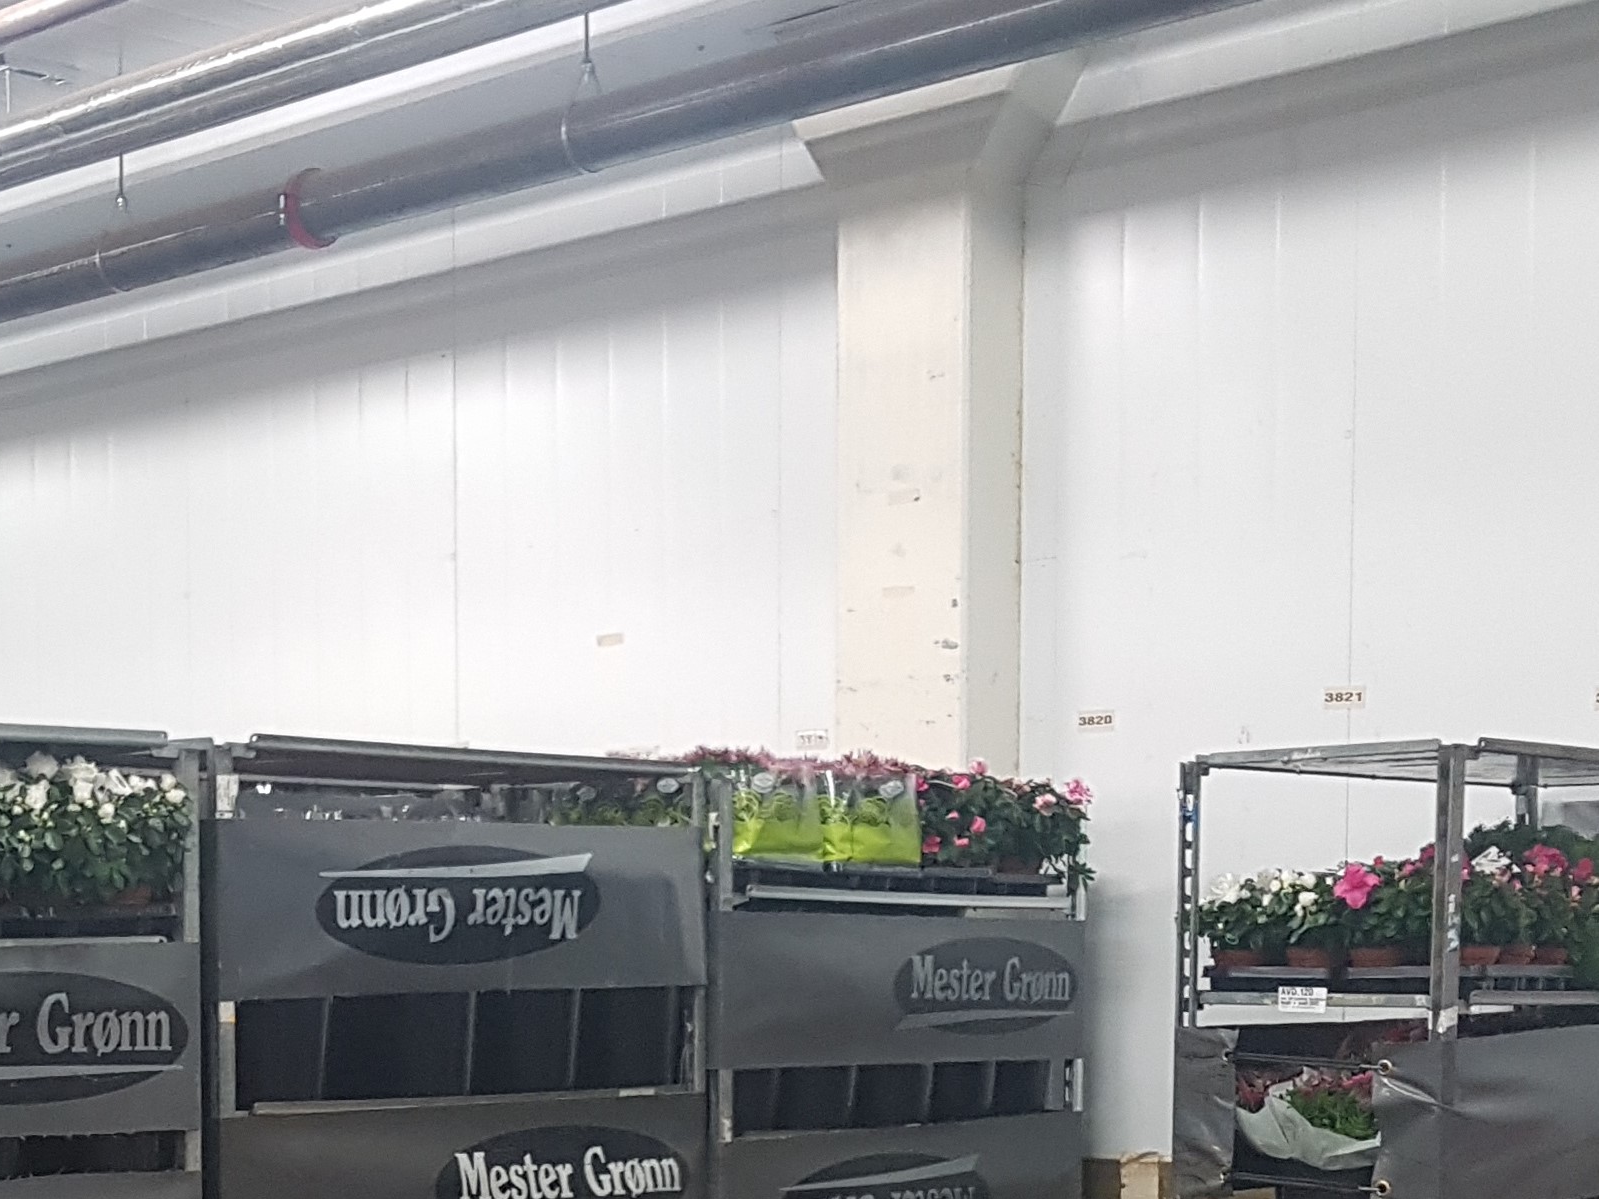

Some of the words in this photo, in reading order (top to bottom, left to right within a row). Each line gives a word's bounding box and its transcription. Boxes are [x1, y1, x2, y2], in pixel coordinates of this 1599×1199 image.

[1078, 716, 1113, 726] 3820
[1324, 692, 1363, 703] 3821
[333, 884, 456, 943] Grønn
[466, 887, 582, 940] Mester
[910, 955, 997, 1001] Mester
[37, 992, 172, 1057] Grønn
[583, 1146, 682, 1198] Grønn
